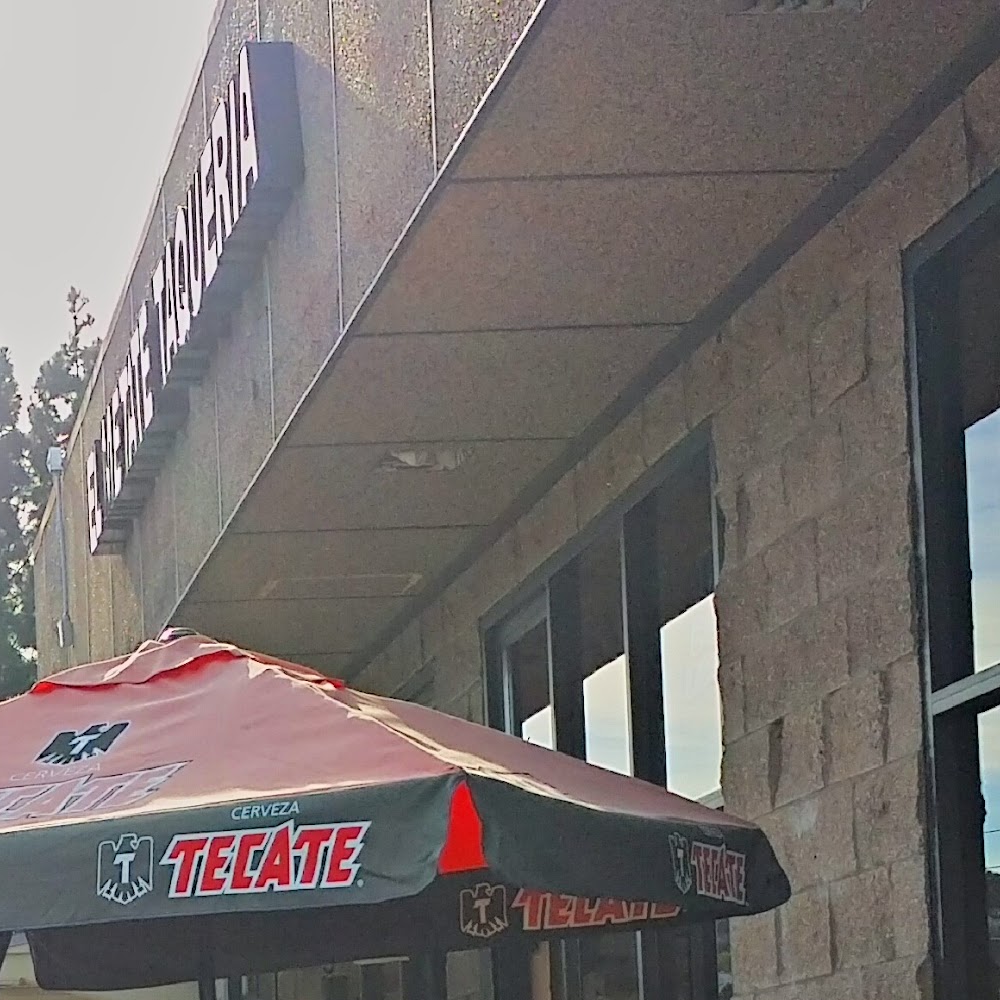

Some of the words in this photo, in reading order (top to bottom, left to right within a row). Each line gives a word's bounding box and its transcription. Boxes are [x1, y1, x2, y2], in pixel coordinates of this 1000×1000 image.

[87, 446, 103, 553] EL
[151, 44, 259, 388] TAQUERIA
[9, 764, 102, 782] CERVEZA
[231, 801, 300, 820] CERVEZA
[159, 819, 373, 898] TECATE
[691, 841, 747, 906] TECATE
